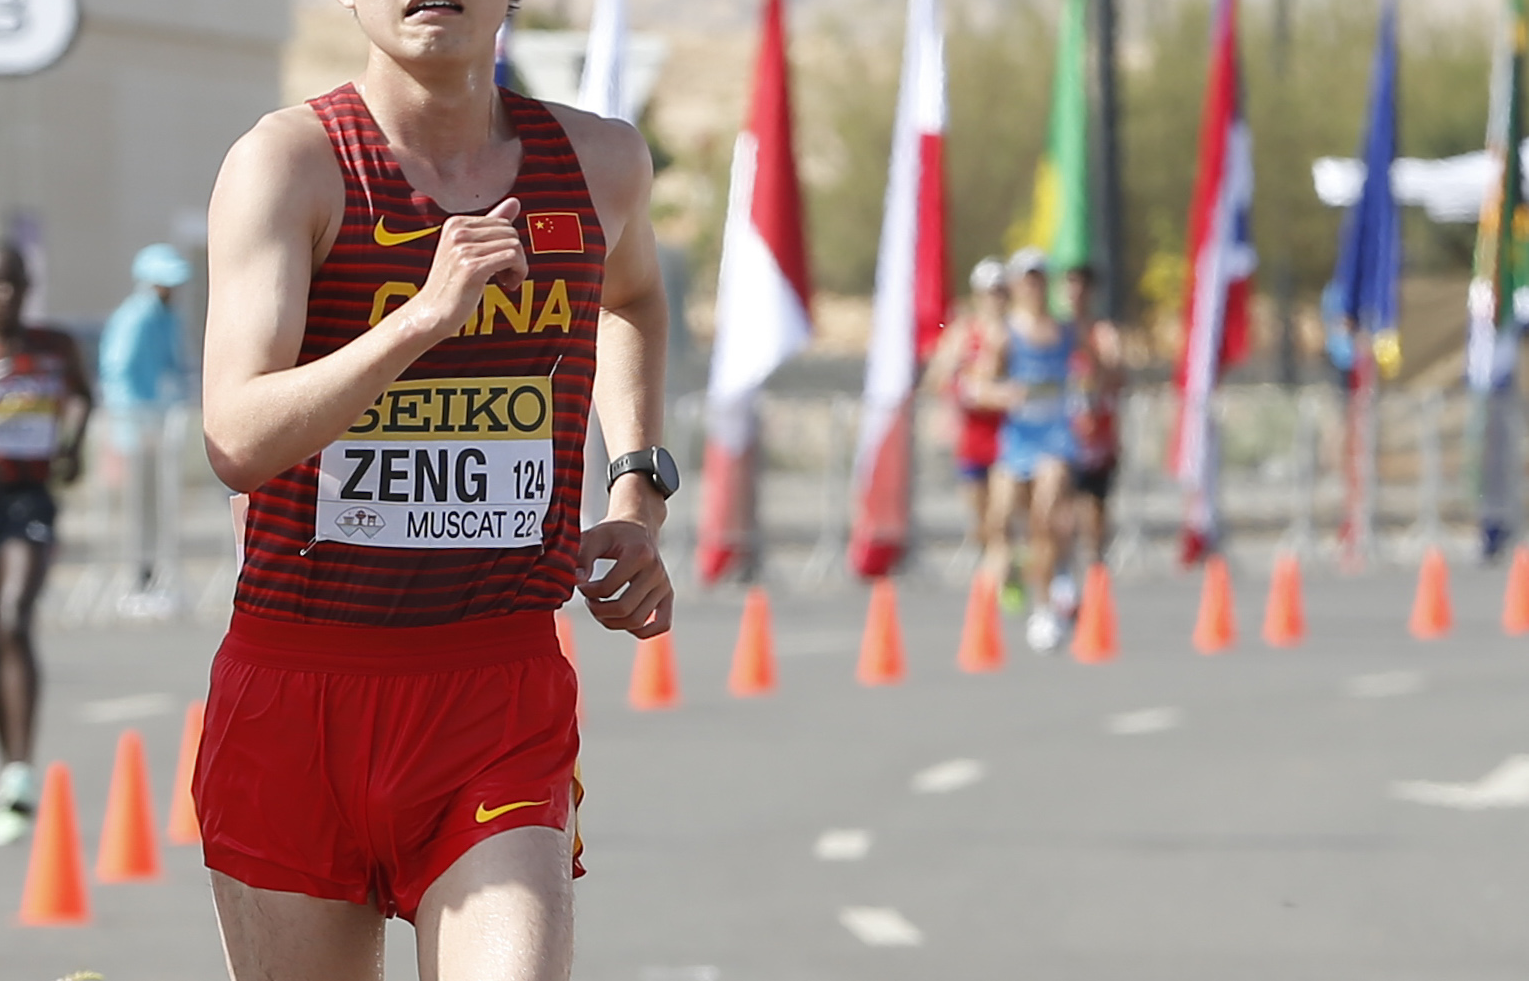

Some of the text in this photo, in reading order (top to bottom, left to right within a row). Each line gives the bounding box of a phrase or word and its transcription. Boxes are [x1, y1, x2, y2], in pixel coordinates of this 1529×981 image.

[339, 447, 546, 503] ZENG 124
[406, 510, 538, 539] MUSCAT 22
